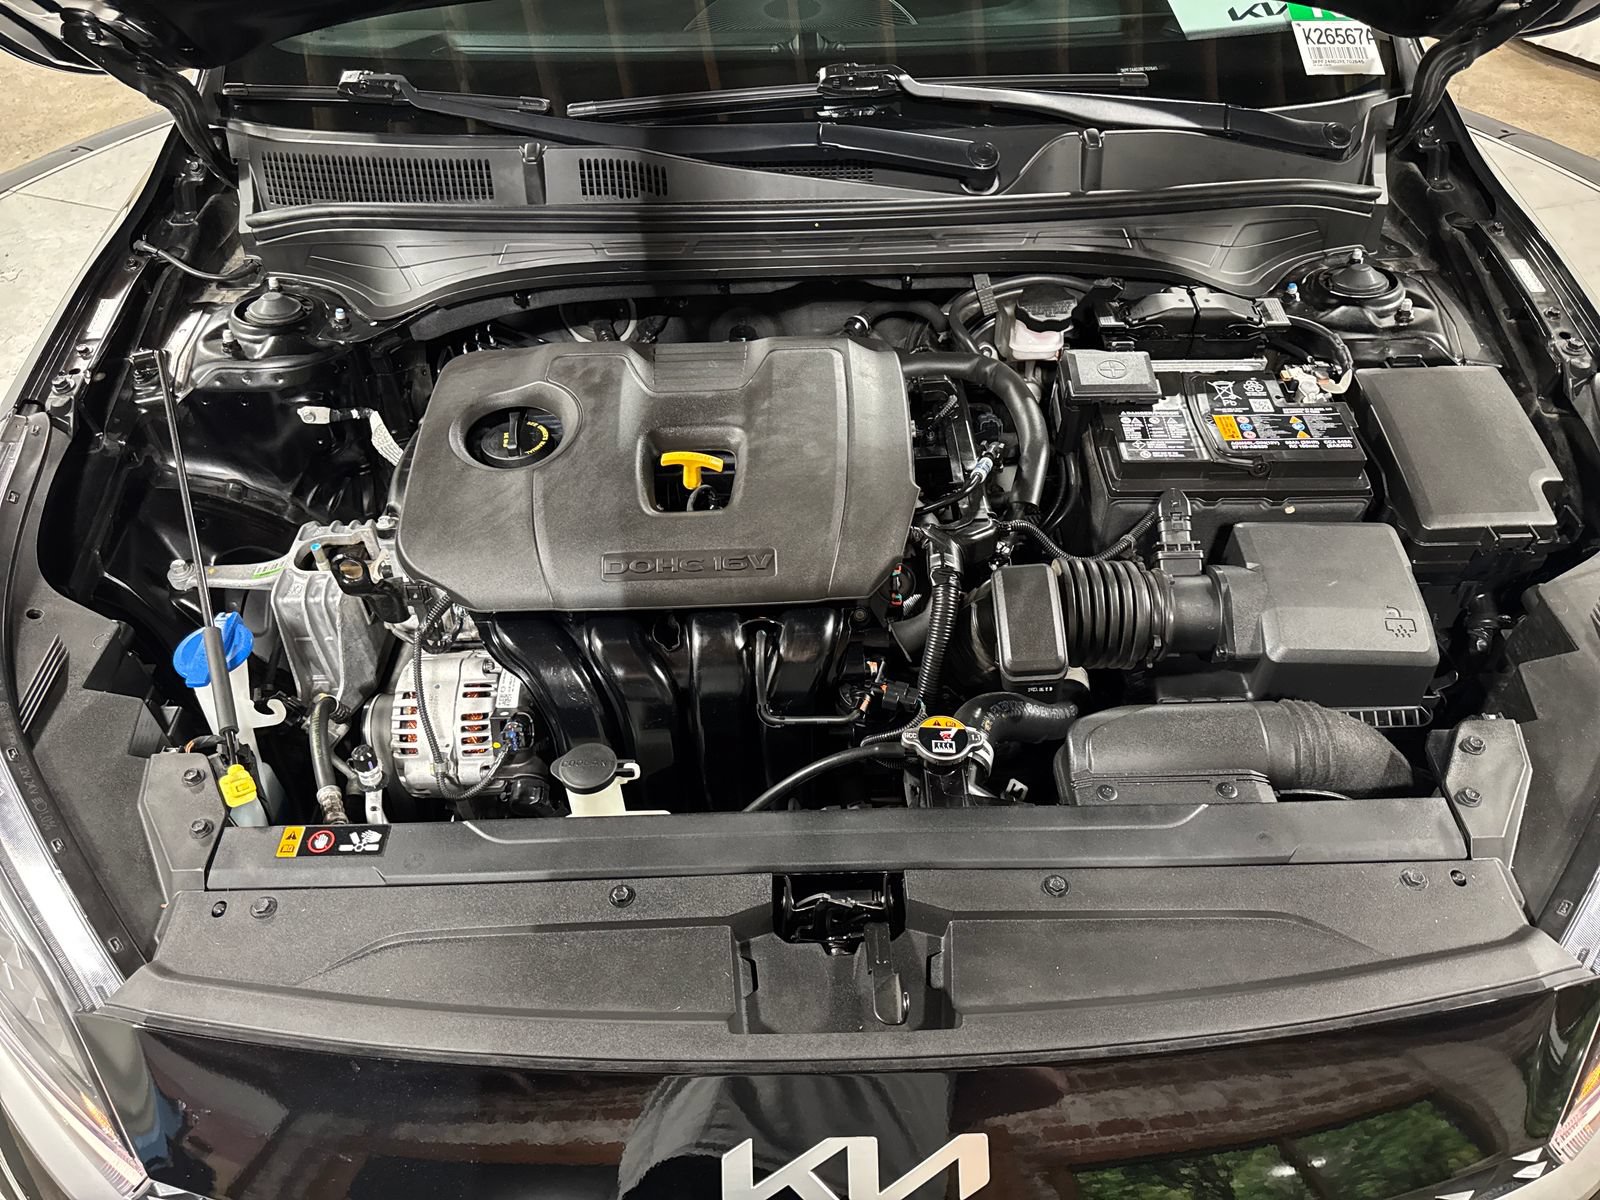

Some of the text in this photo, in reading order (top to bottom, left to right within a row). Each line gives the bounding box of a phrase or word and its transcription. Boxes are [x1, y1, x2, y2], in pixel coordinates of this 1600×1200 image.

[1302, 27, 1375, 45] K26567A
[603, 553, 775, 574] DOHC 16V
